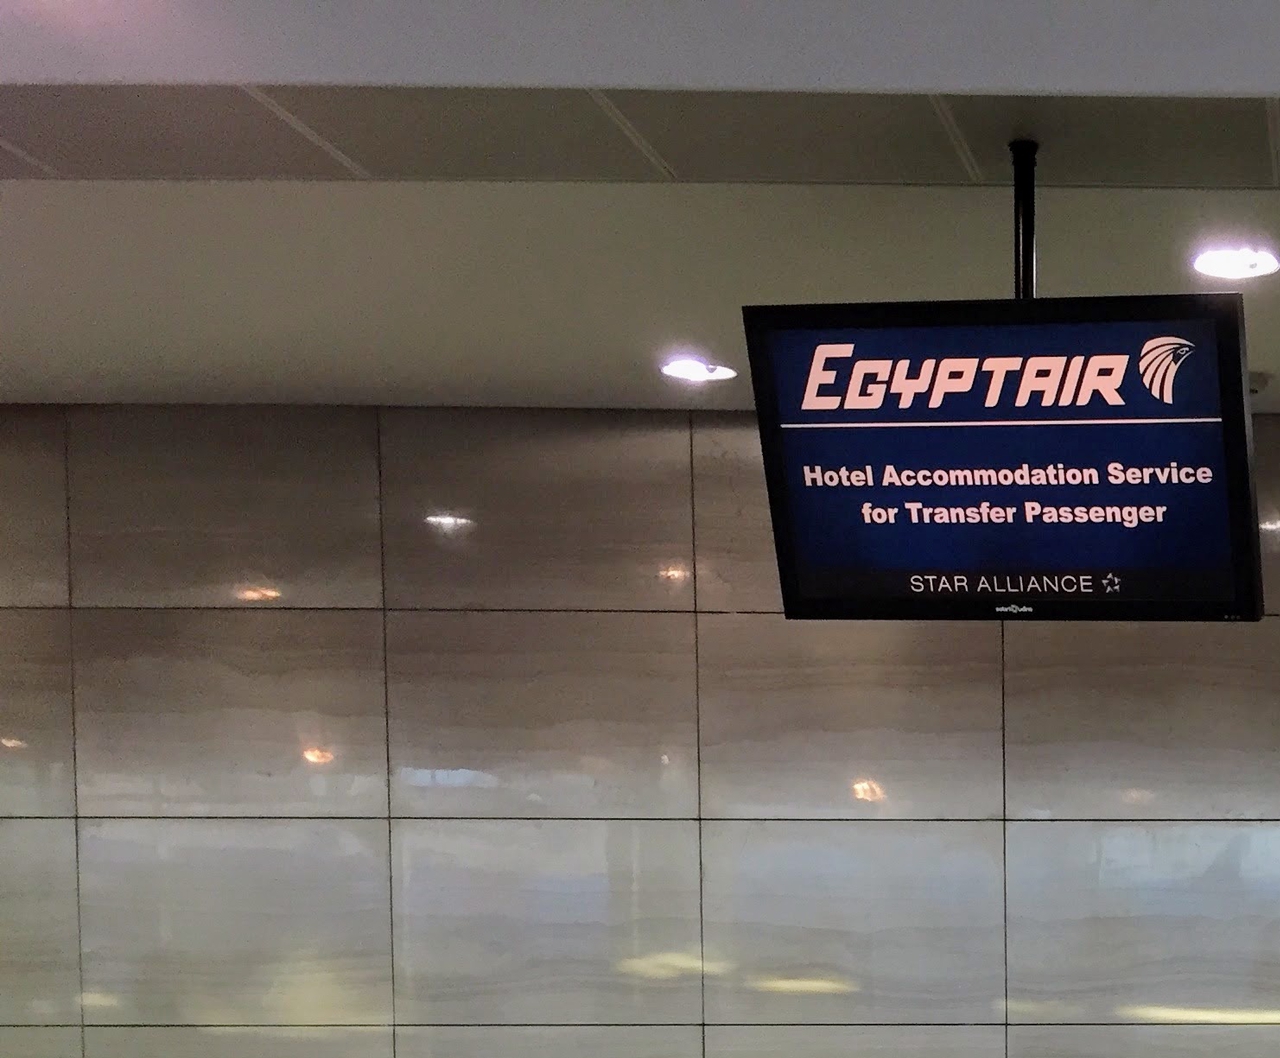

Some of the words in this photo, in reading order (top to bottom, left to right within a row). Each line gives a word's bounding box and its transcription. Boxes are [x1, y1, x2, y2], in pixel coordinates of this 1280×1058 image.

[801, 343, 1130, 410] EGYPTAIR
[803, 465, 874, 488] Hotel
[882, 462, 1100, 487] Accommodation
[1107, 461, 1213, 485] Service
[861, 502, 898, 525] for
[904, 501, 1017, 525] Transfer
[1024, 501, 1167, 528] Passenger
[910, 575, 969, 593] STAR
[977, 574, 1093, 593] ALLIANCE
